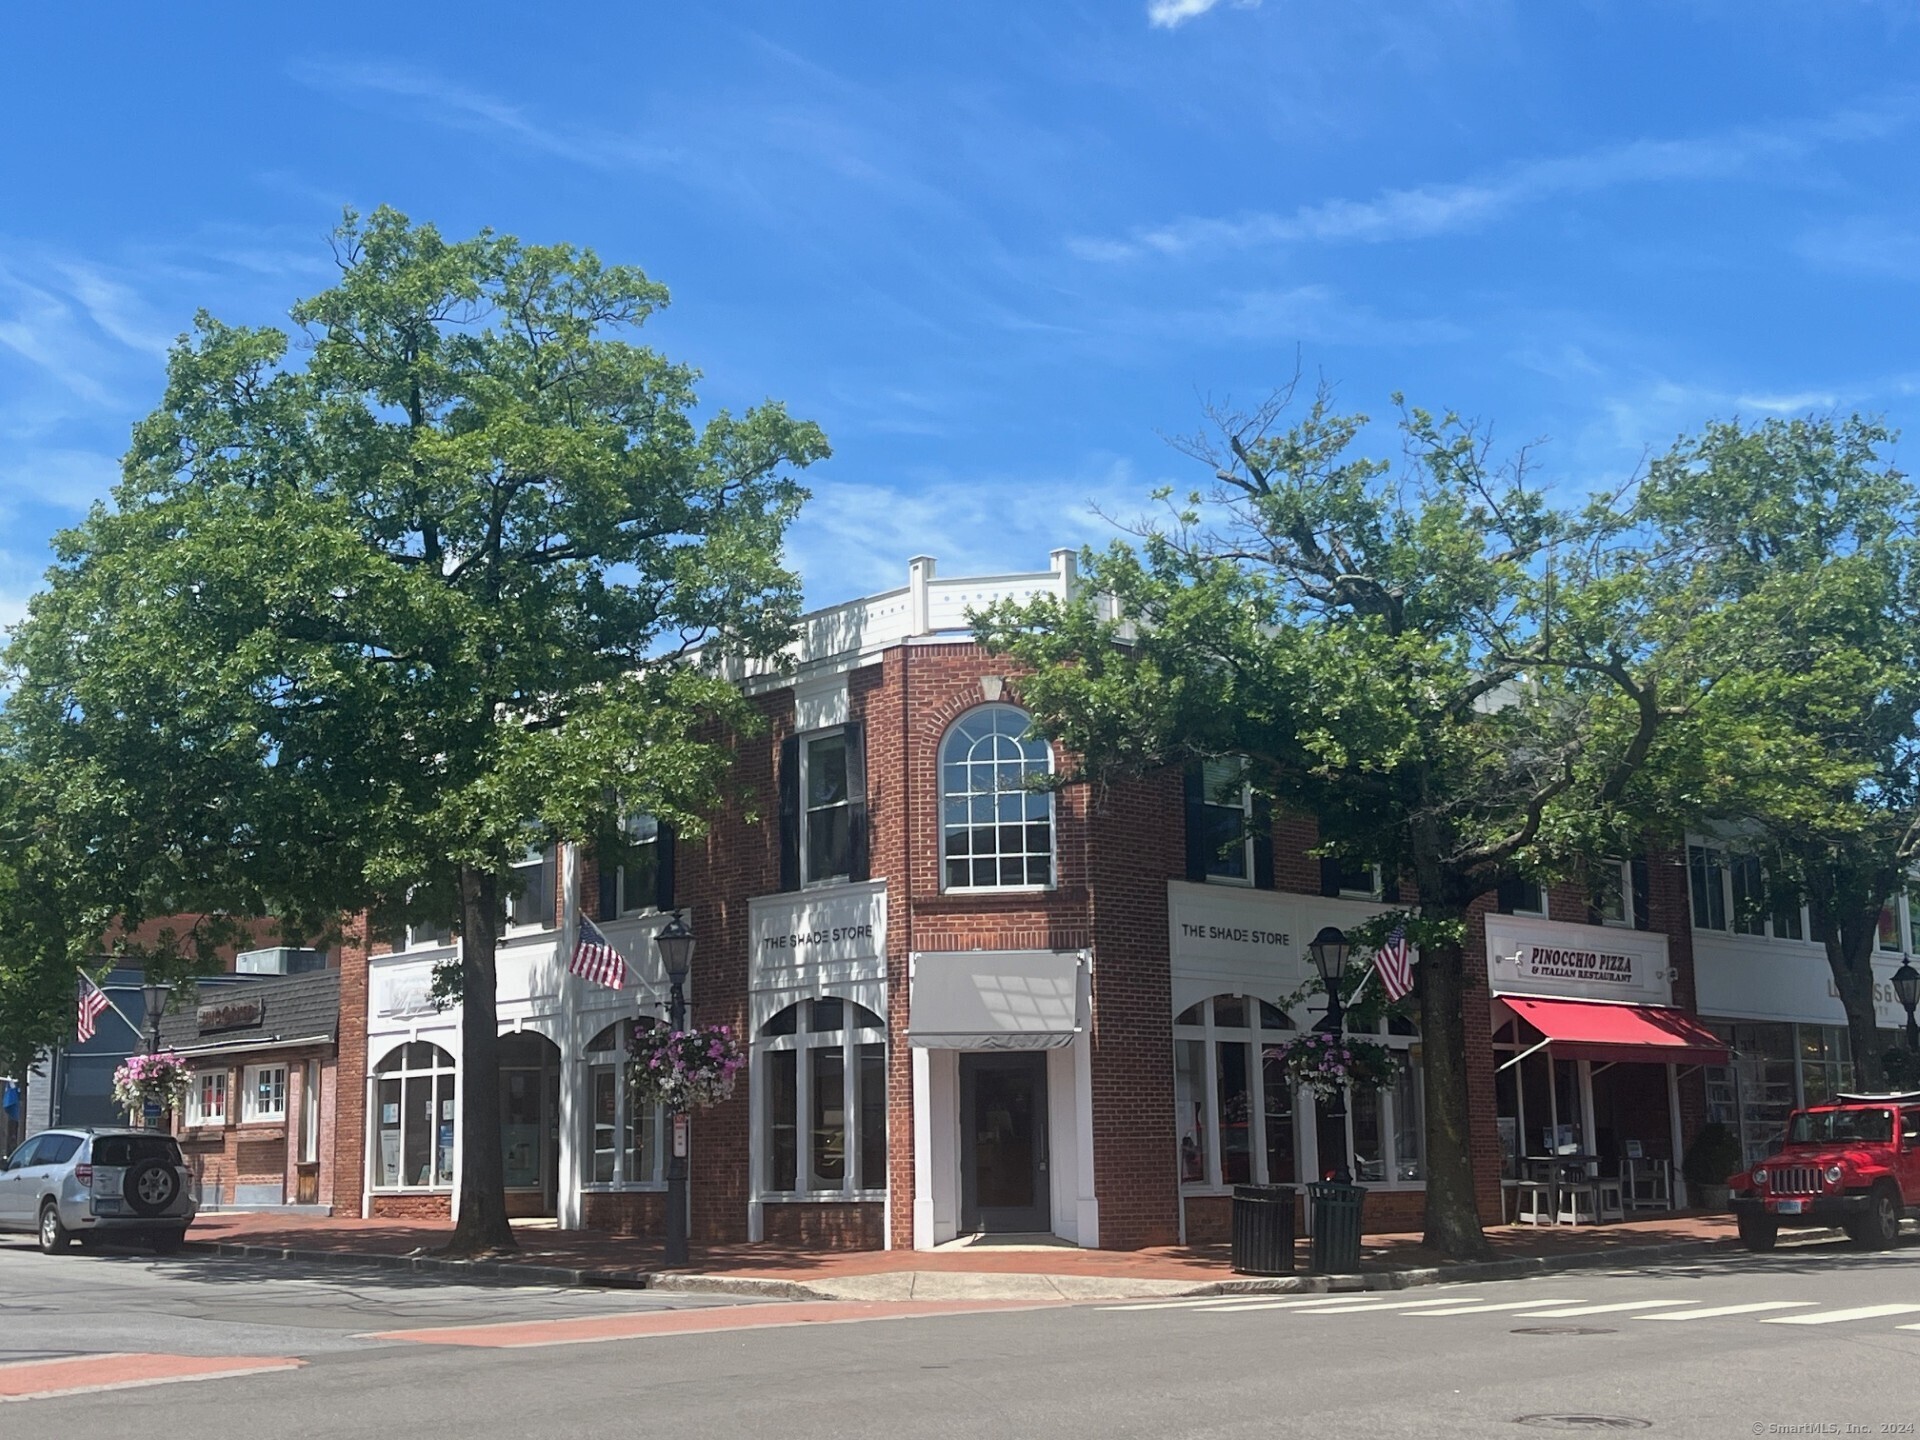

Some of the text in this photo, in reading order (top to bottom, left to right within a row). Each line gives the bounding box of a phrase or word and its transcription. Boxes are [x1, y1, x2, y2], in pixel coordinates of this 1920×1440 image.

[763, 924, 873, 949] THE SHADE STORE
[1181, 924, 1290, 946] THE SHADE STORE
[1531, 947, 1632, 973] PINOCCHIO PIZZA
[1531, 965, 1633, 983] & ITALIAN RESTAURANT
